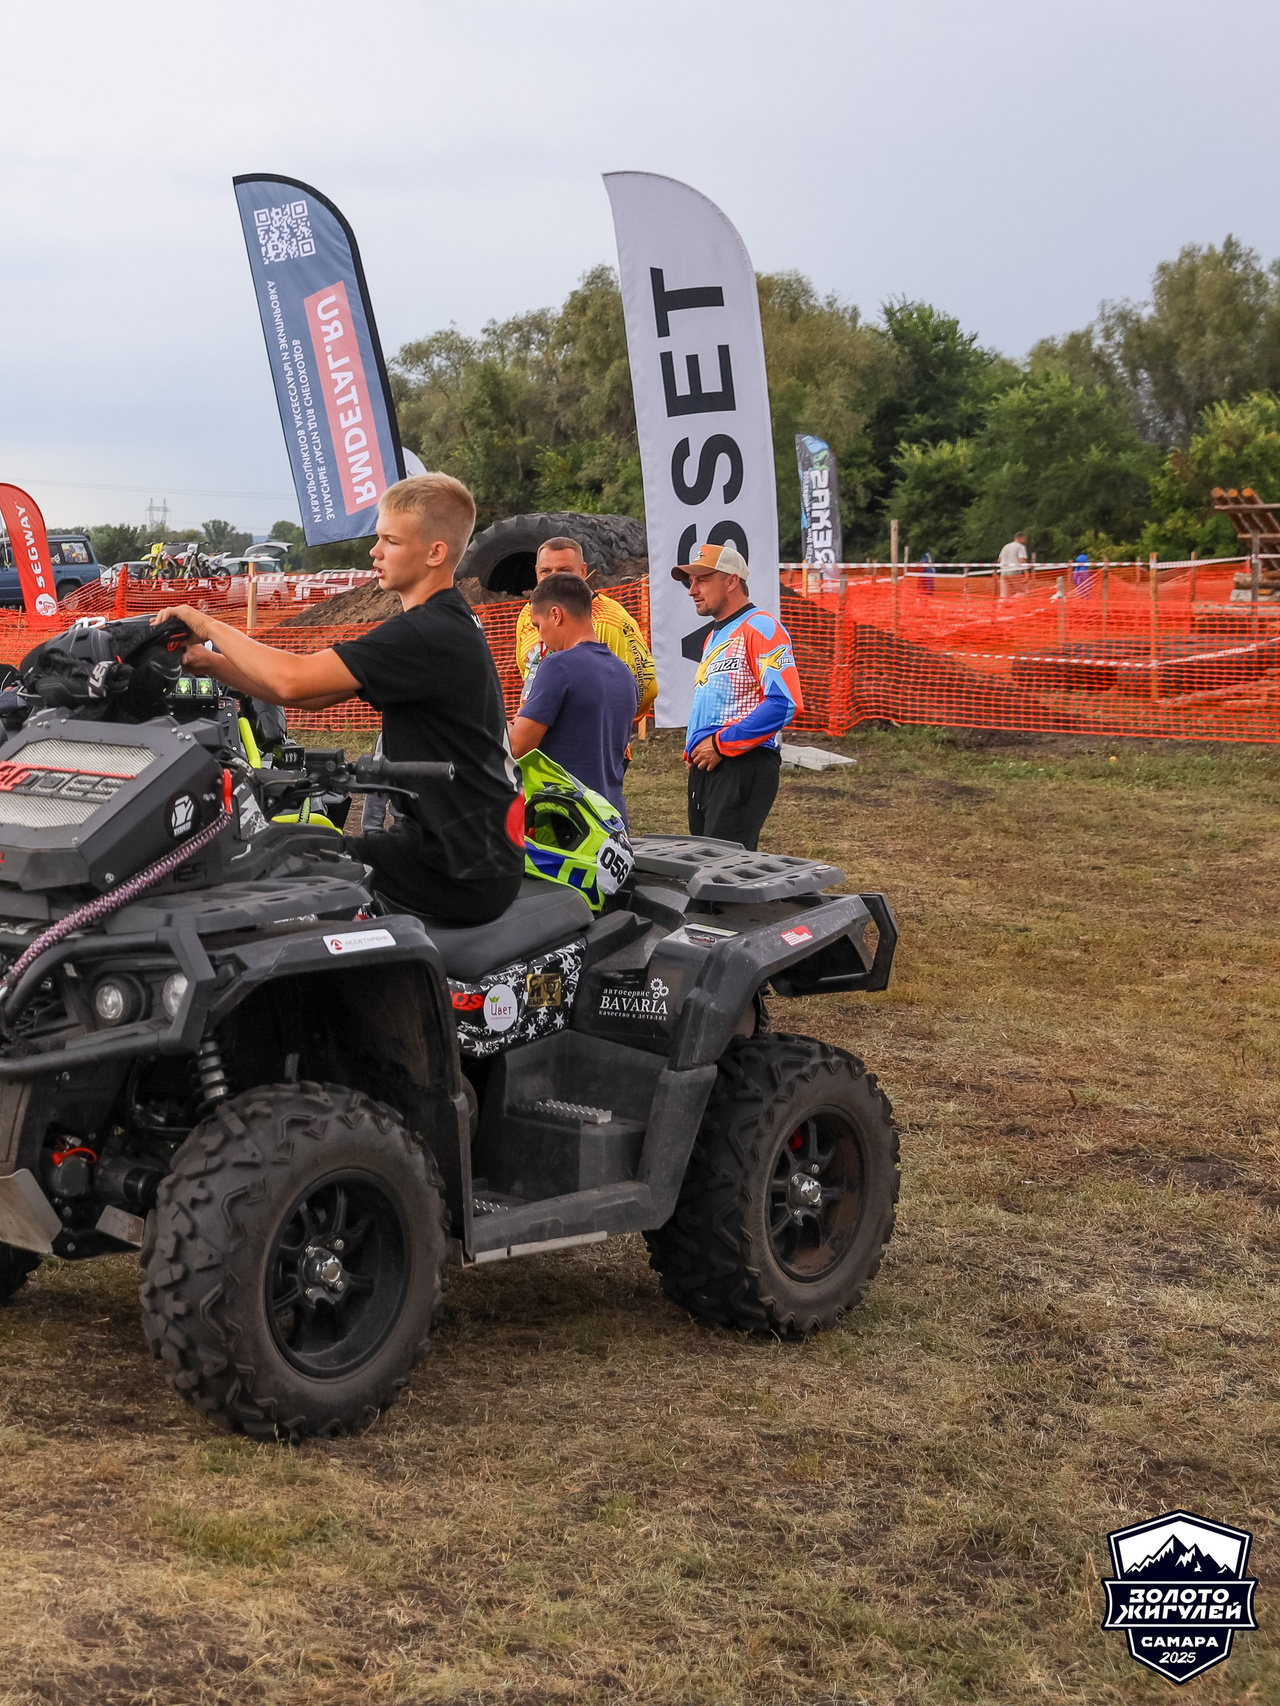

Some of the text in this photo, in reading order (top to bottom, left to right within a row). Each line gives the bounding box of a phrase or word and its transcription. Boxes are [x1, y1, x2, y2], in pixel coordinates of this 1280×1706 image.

[650, 267, 749, 662] SSET
[15, 504, 46, 588] SEGWAY
[600, 846, 629, 885] 056
[600, 995, 668, 1014] BAVARIA
[603, 988, 650, 999] автосервис
[598, 1010, 630, 1018] качество
